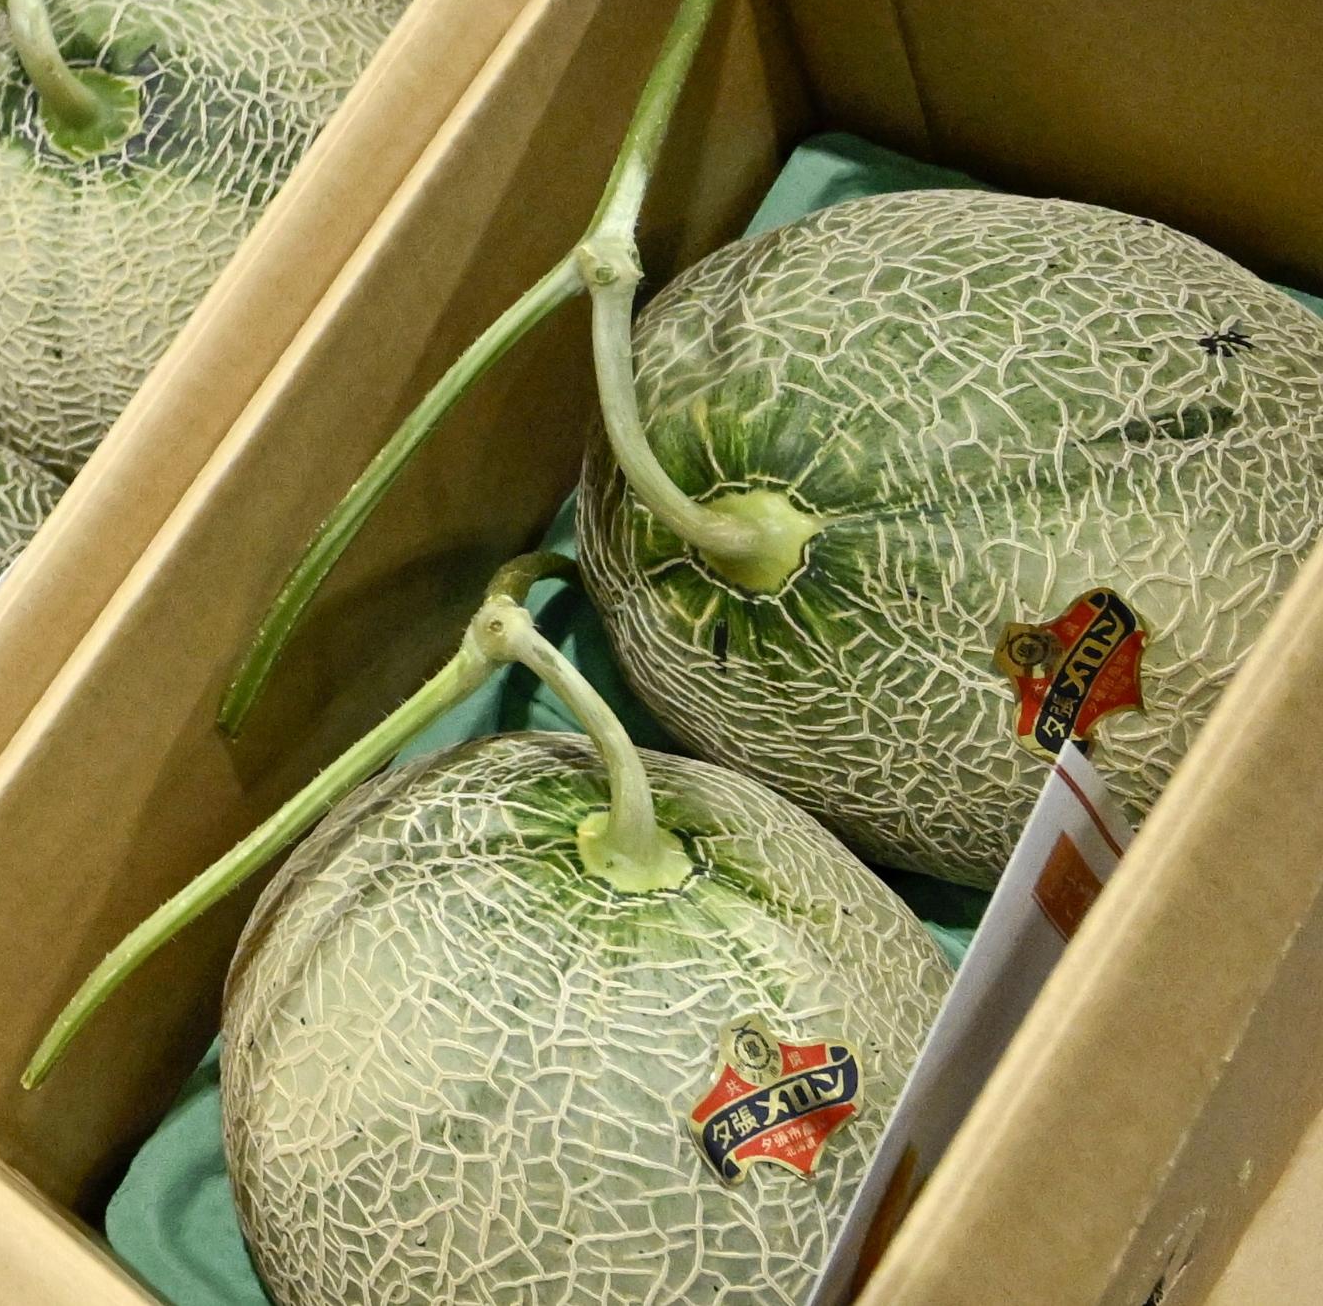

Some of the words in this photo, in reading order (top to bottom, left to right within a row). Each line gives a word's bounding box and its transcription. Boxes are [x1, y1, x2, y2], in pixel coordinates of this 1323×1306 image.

[1041, 609, 1125, 739] 夕張メロン
[712, 1068, 847, 1151] 夕張メロン
